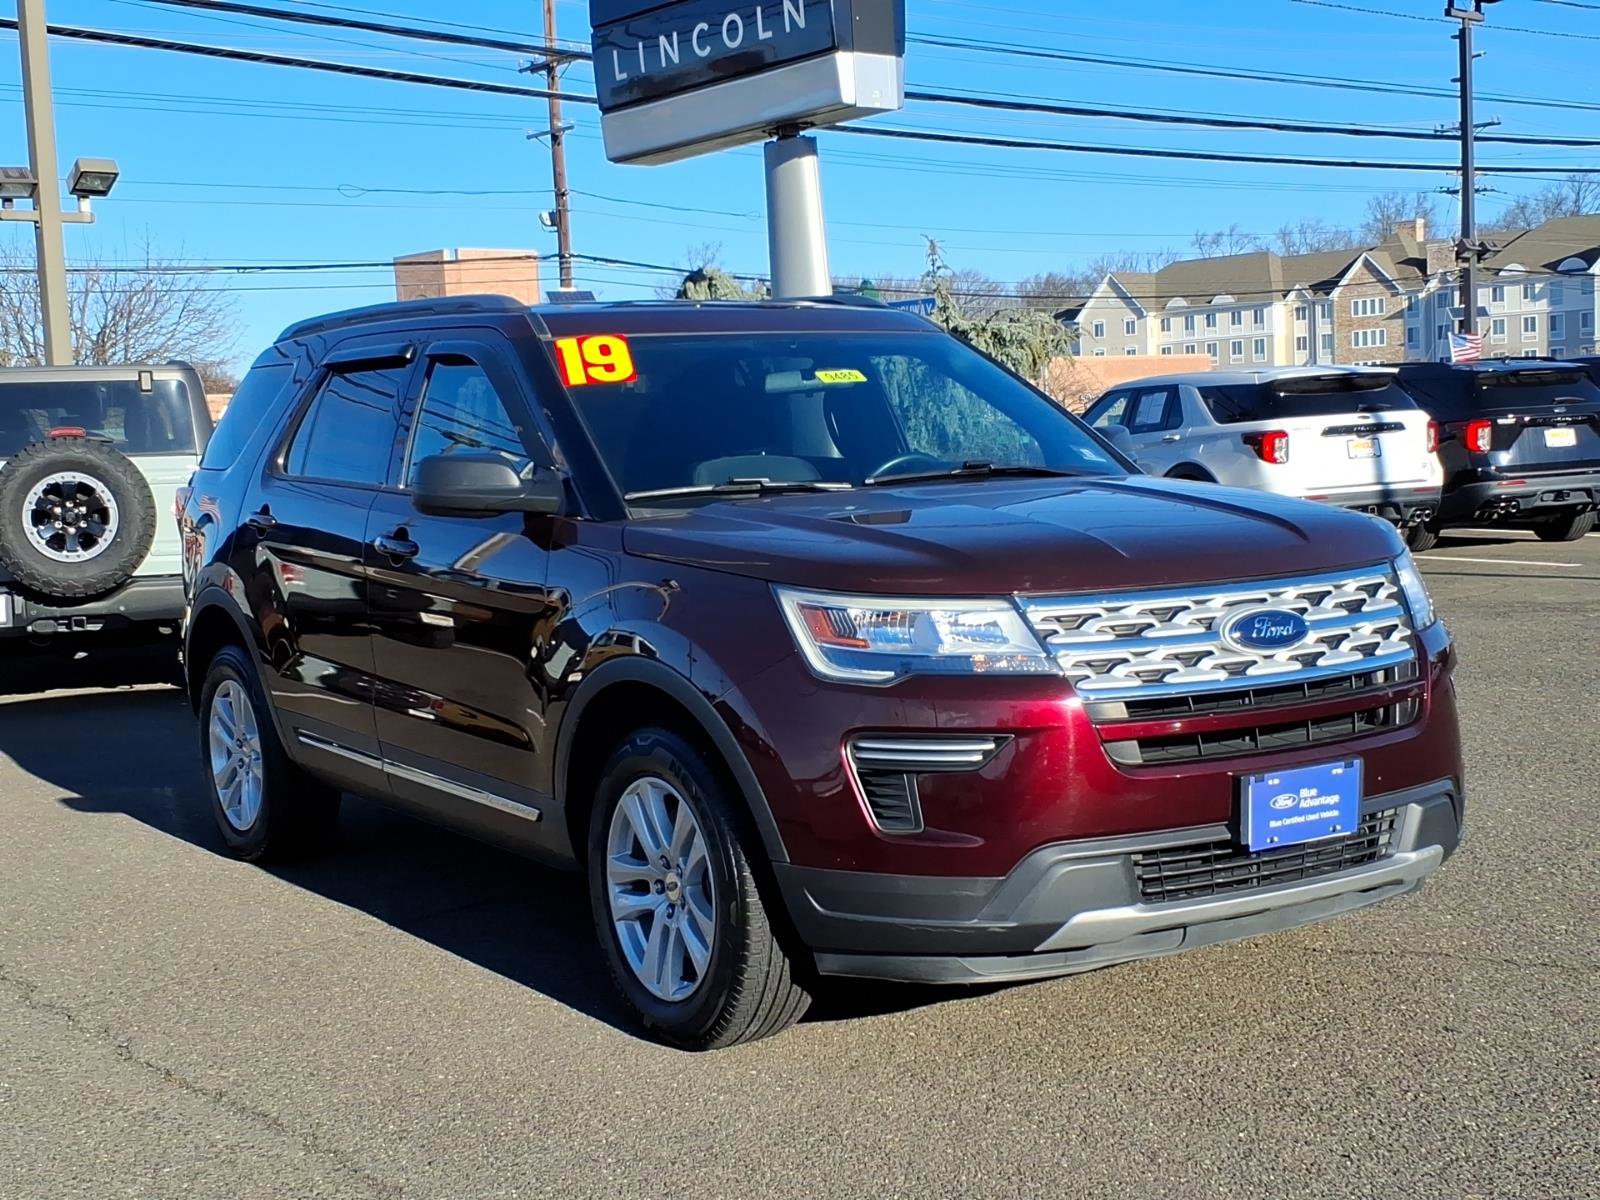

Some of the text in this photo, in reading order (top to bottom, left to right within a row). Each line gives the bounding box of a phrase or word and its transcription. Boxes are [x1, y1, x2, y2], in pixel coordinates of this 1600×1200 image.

[613, 0, 805, 81] LINCOLN
[556, 336, 634, 385] 19
[1252, 616, 1297, 639] Ford
[1299, 794, 1340, 809] Advantage
[1300, 787, 1317, 798] Blue
[1283, 815, 1305, 825] Certified
